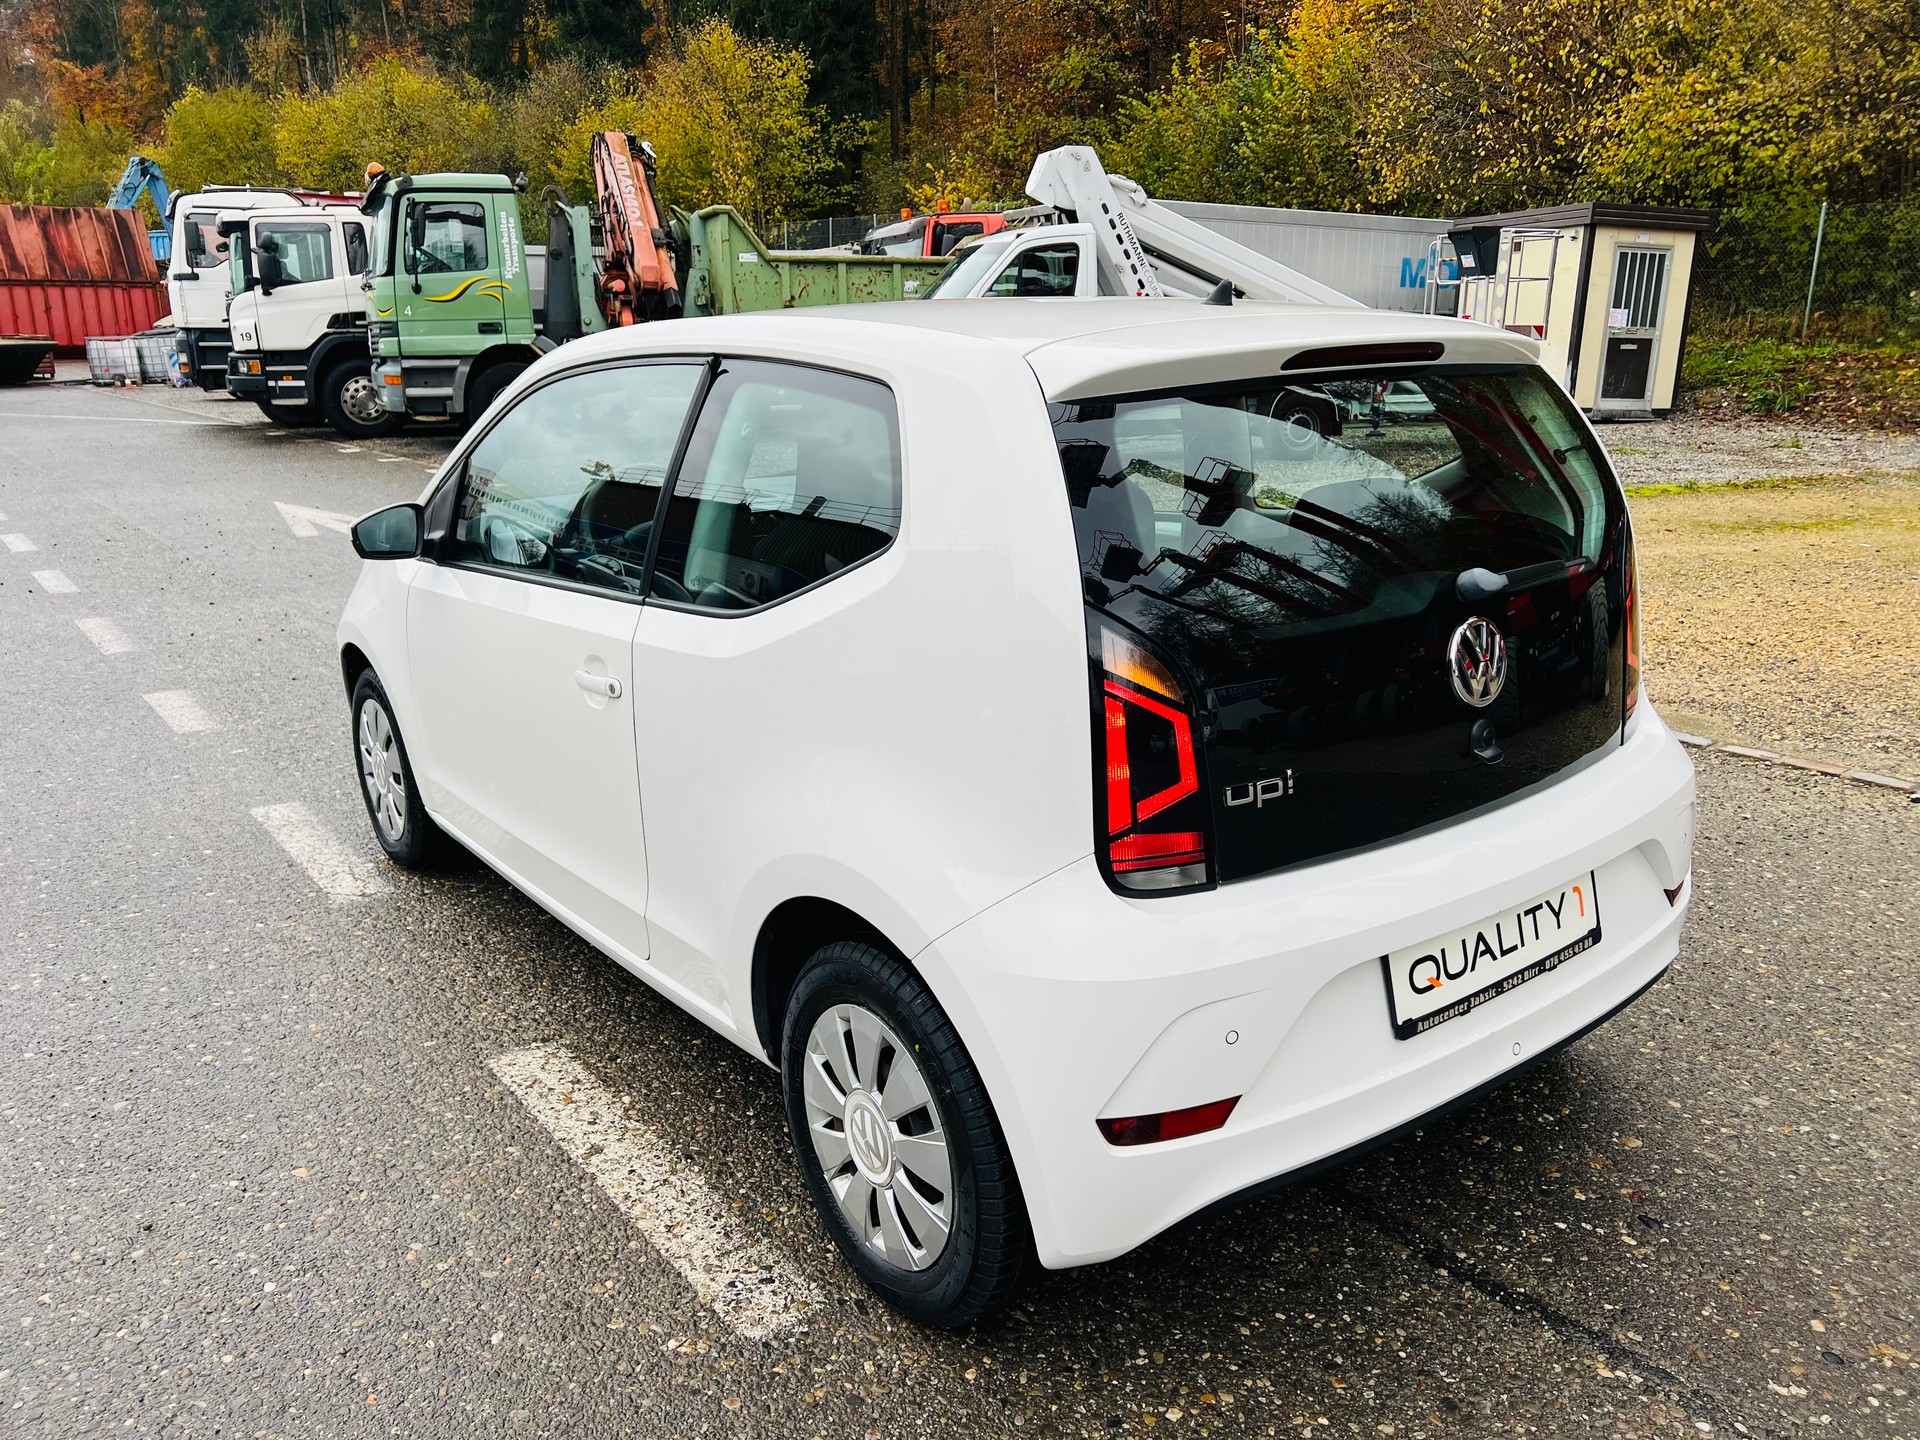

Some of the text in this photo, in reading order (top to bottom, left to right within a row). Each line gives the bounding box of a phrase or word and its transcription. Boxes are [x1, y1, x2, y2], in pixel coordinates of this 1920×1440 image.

[500, 211, 513, 279] Kranarbeiten
[508, 217, 520, 274] Transporte
[239, 332, 252, 342] 19
[404, 305, 412, 317] 4
[1224, 769, 1294, 808] up!
[1408, 892, 1566, 995] QUALITY
[1417, 1001, 1469, 1033] Autocenter
[1469, 988, 1497, 1008] Jaksic
[1503, 974, 1523, 992] 5242
[1523, 966, 1540, 981] Birr
[1545, 955, 1559, 970] 076
[1560, 948, 1573, 961] 455
[1574, 942, 1583, 954] 43
